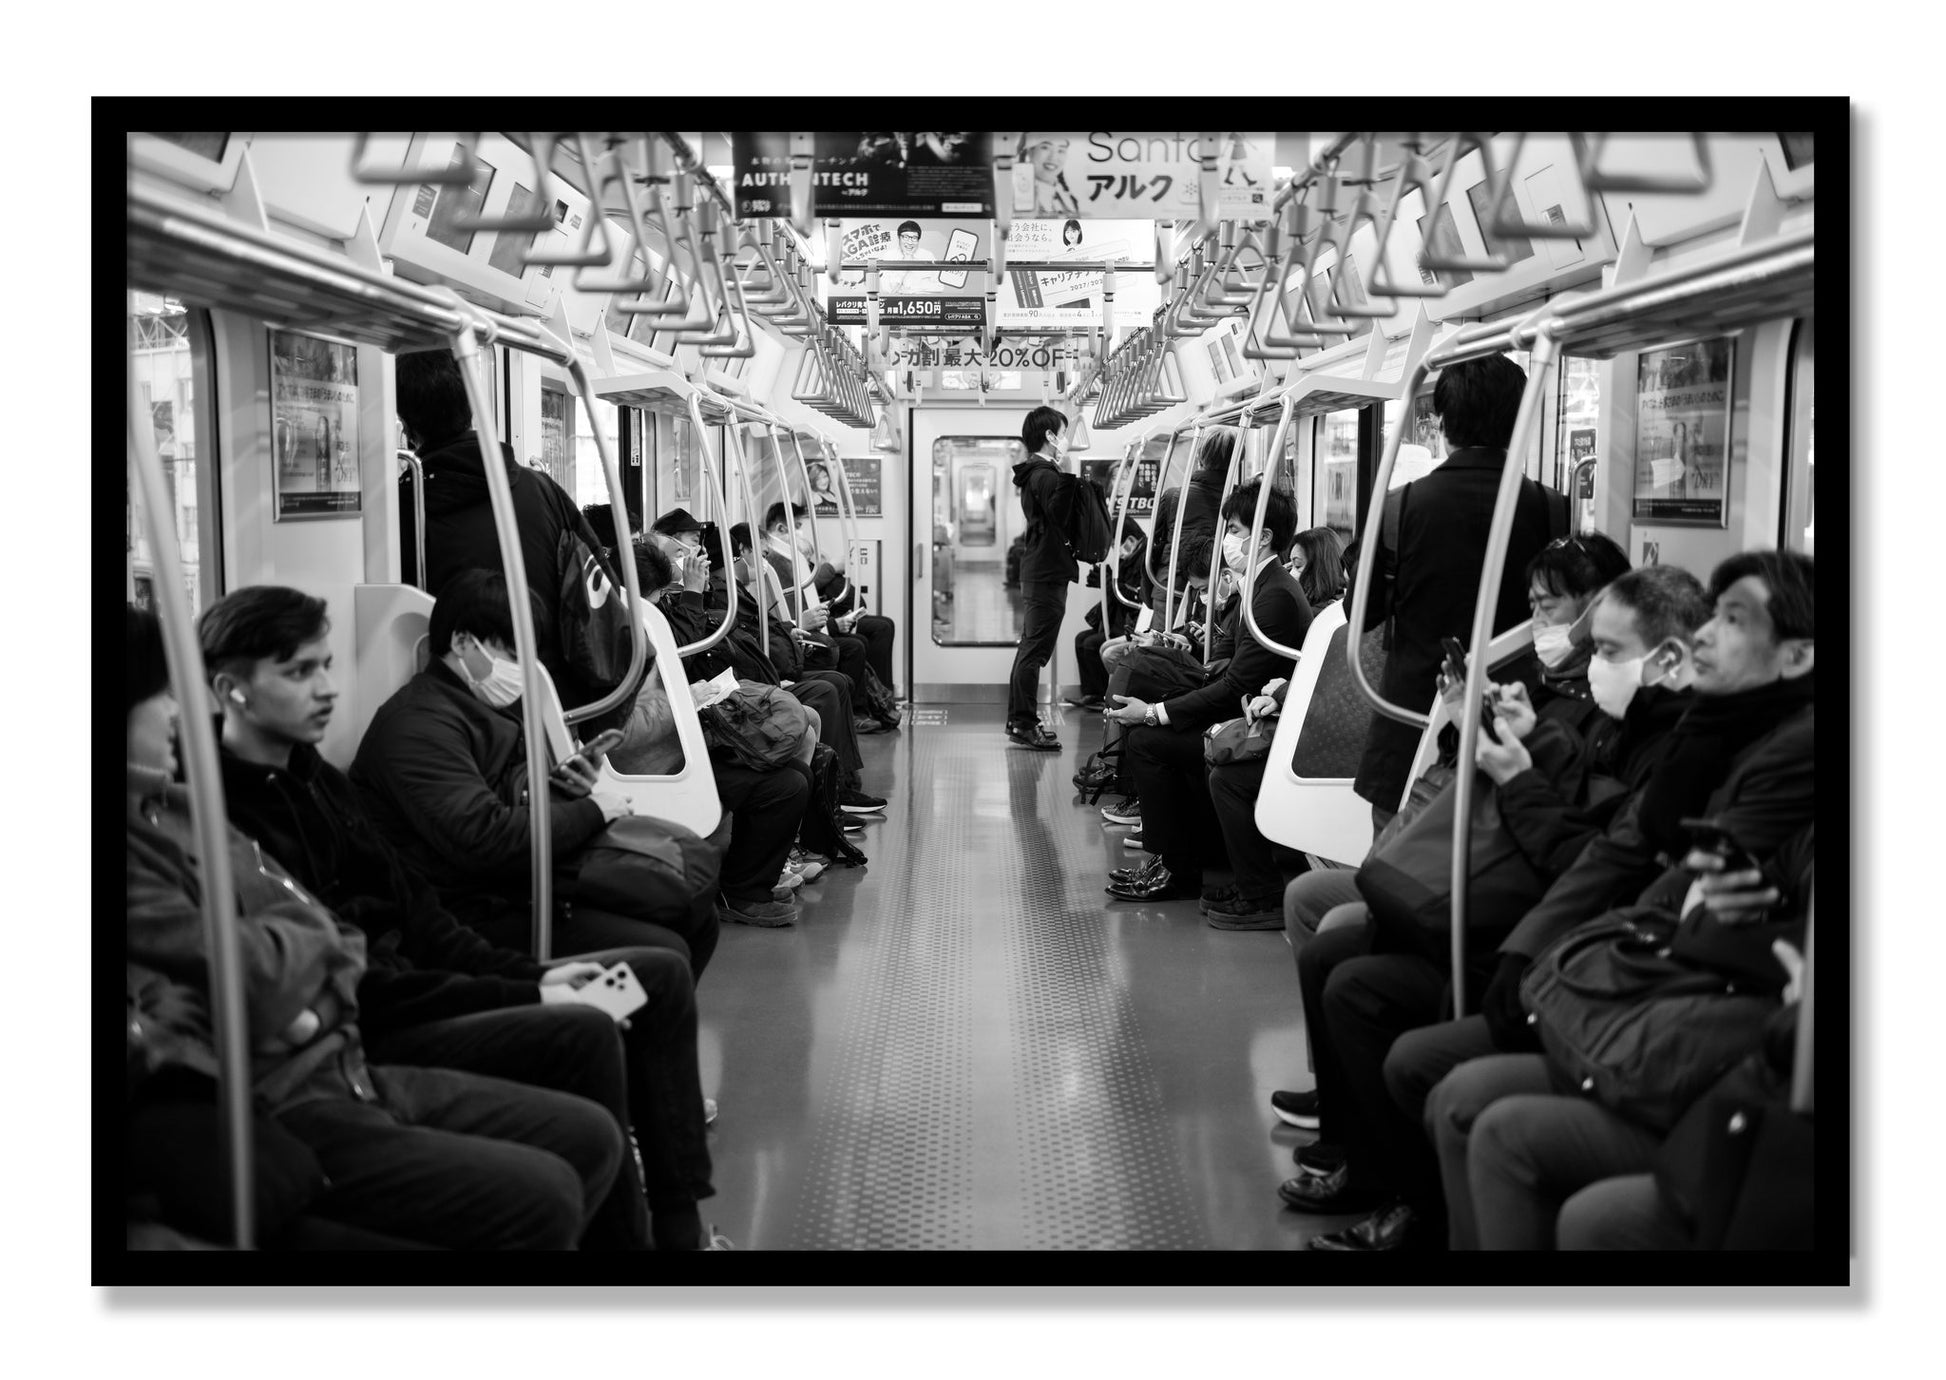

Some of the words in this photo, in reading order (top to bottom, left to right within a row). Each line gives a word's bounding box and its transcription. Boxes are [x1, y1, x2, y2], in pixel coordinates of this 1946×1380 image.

[741, 172, 868, 188] AUTHNTECH
[1087, 174, 1172, 203] アルク
[841, 223, 881, 247] スマホで
